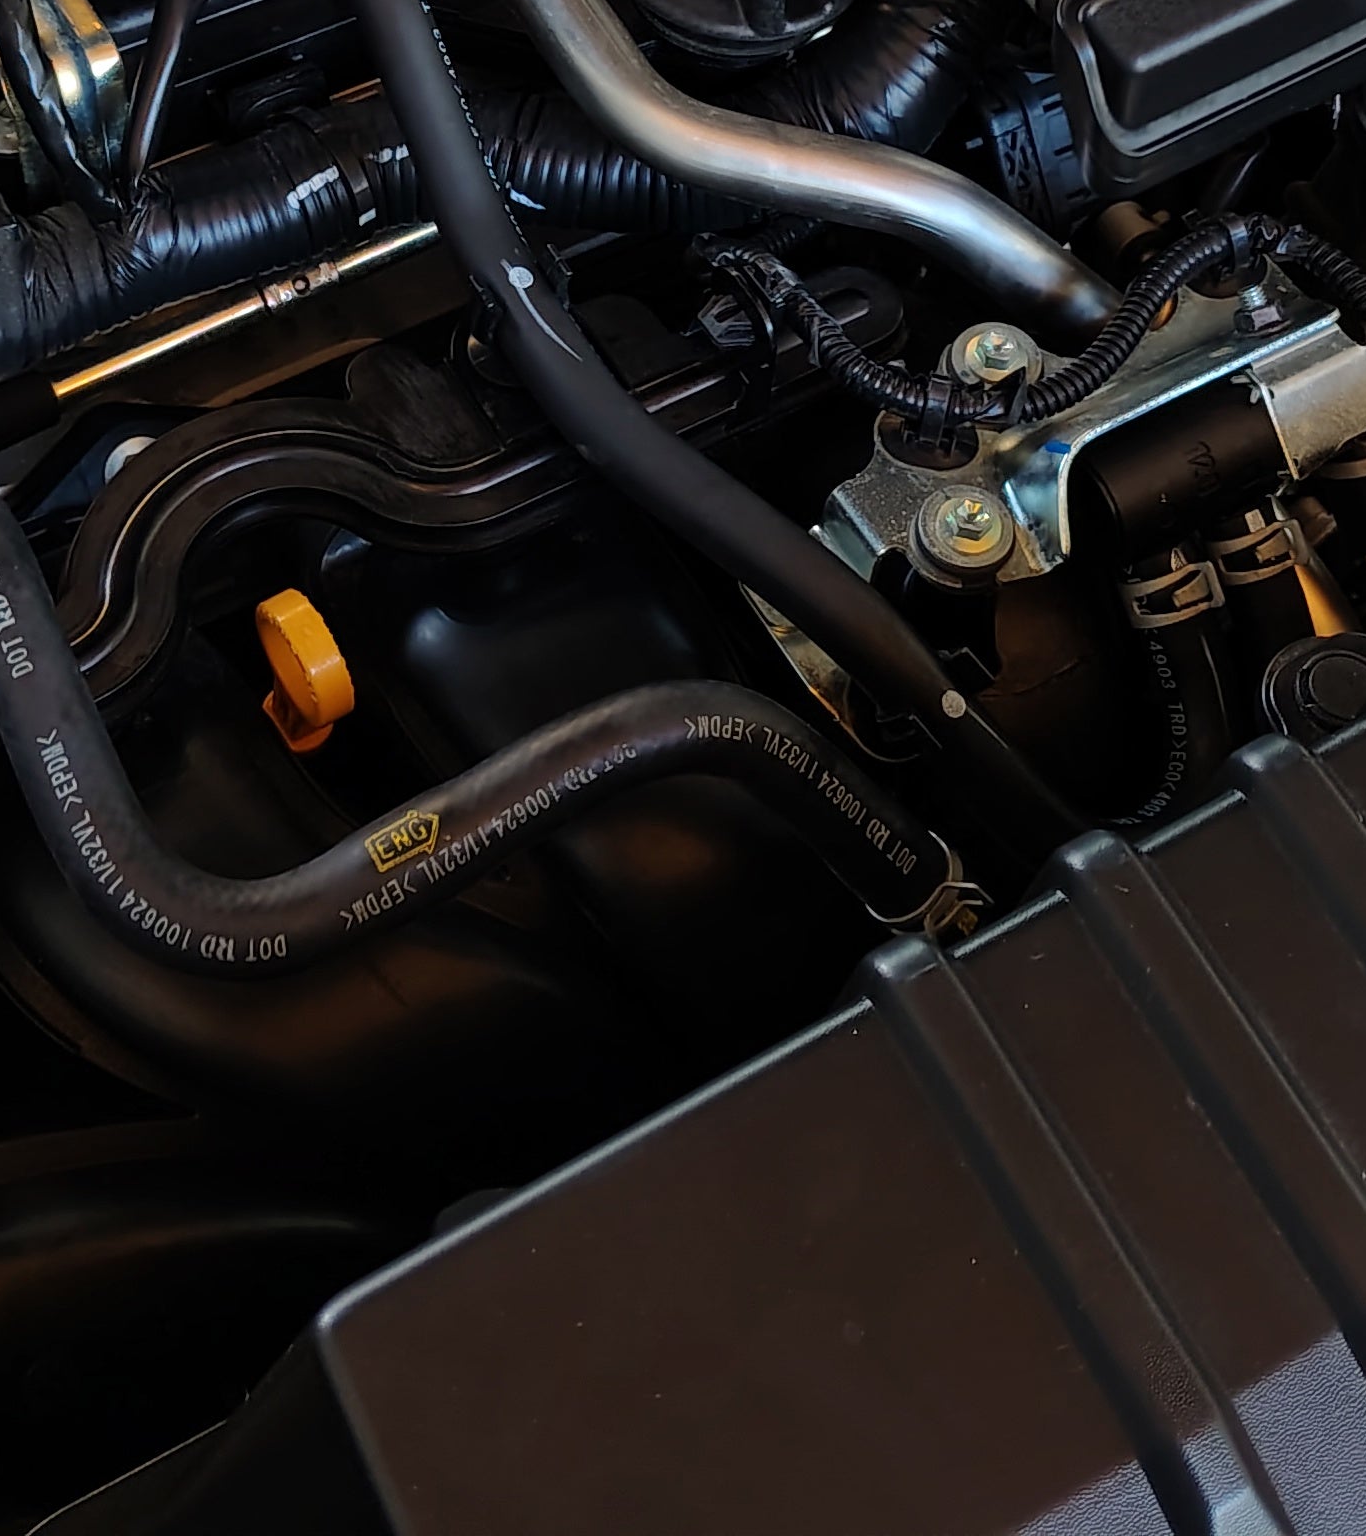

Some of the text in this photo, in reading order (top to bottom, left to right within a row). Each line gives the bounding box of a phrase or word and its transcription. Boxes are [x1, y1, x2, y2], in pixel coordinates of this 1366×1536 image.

[1, 636, 34, 679] DOT
[684, 715, 757, 745] >EPDM<
[36, 728, 83, 813] >EPDM<
[817, 770, 868, 826] 100624
[491, 780, 563, 838] 100624
[886, 839, 918, 875] DOT
[119, 888, 193, 952] 100624
[339, 870, 418, 932] >EPDM<
[245, 934, 287, 962] DOT
